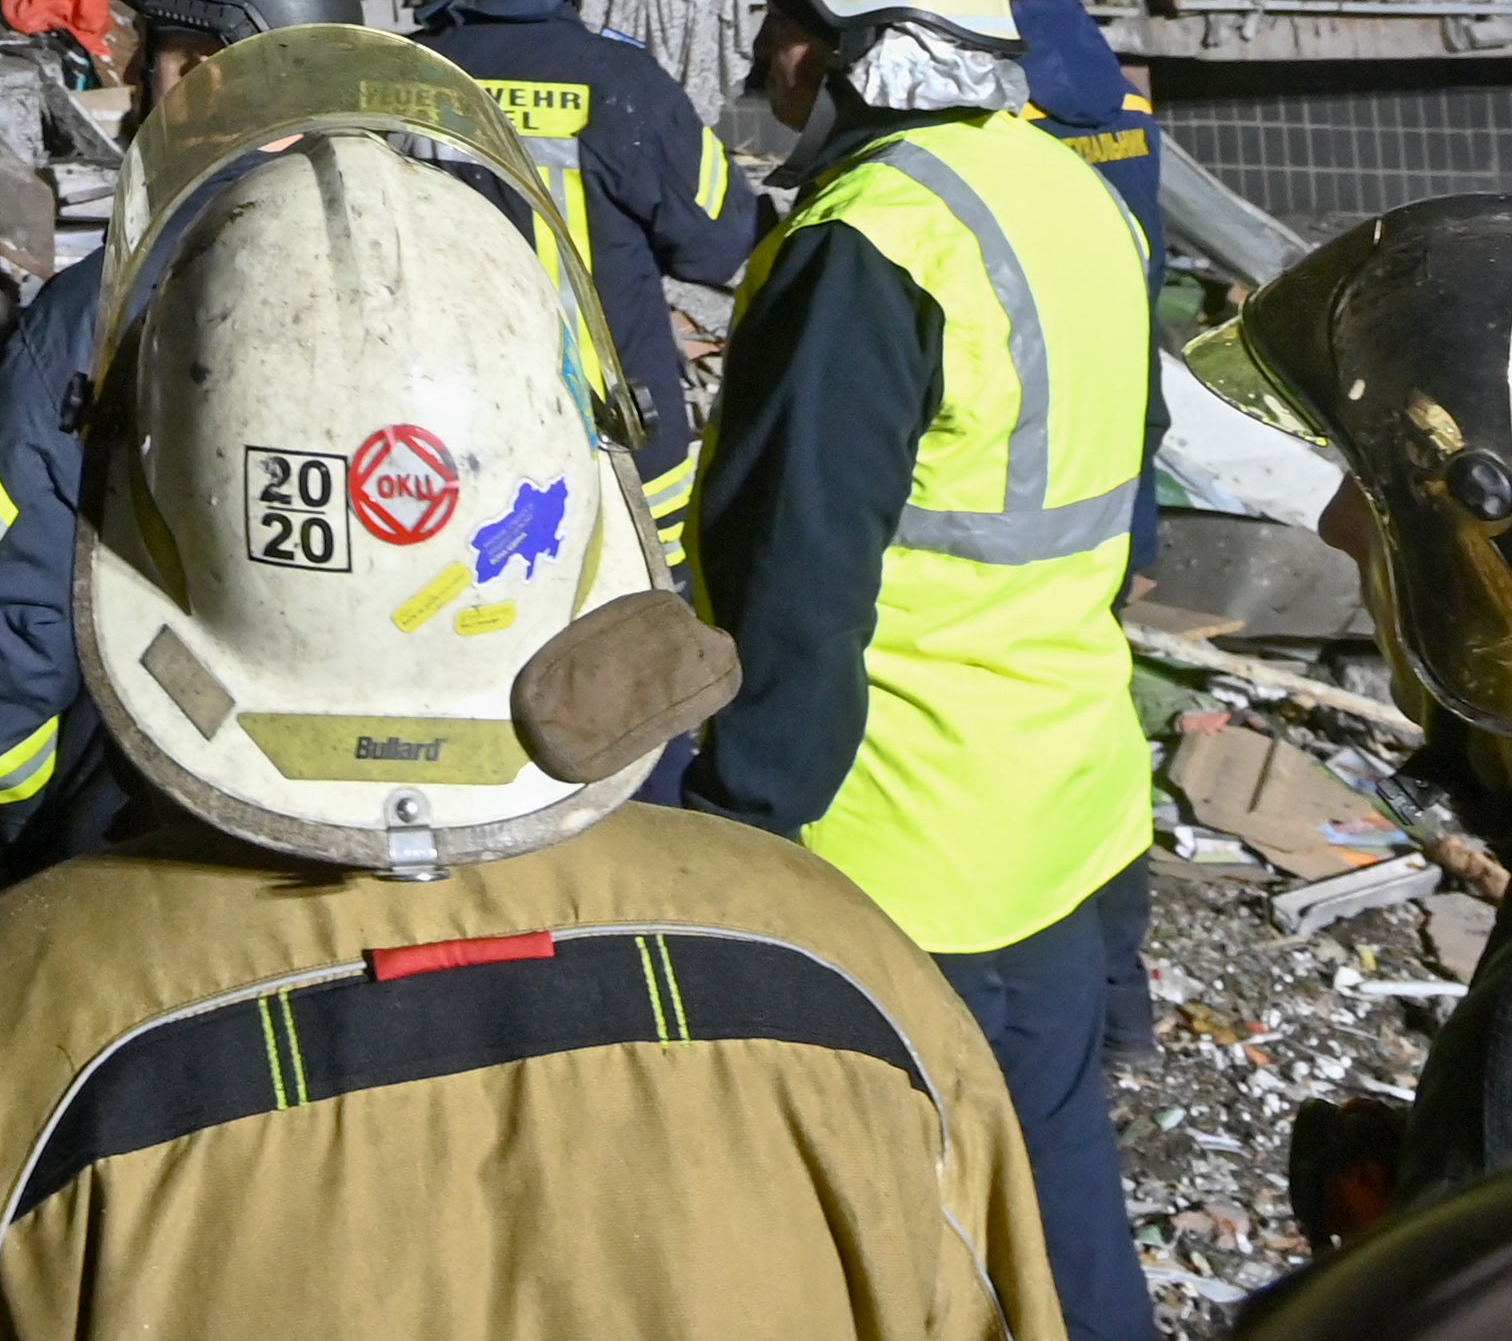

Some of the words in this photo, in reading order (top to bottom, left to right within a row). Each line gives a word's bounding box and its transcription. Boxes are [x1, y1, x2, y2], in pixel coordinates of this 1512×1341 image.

[260, 455, 332, 509] 20
[262, 512, 334, 564] 20
[356, 735, 442, 762] Bullard
